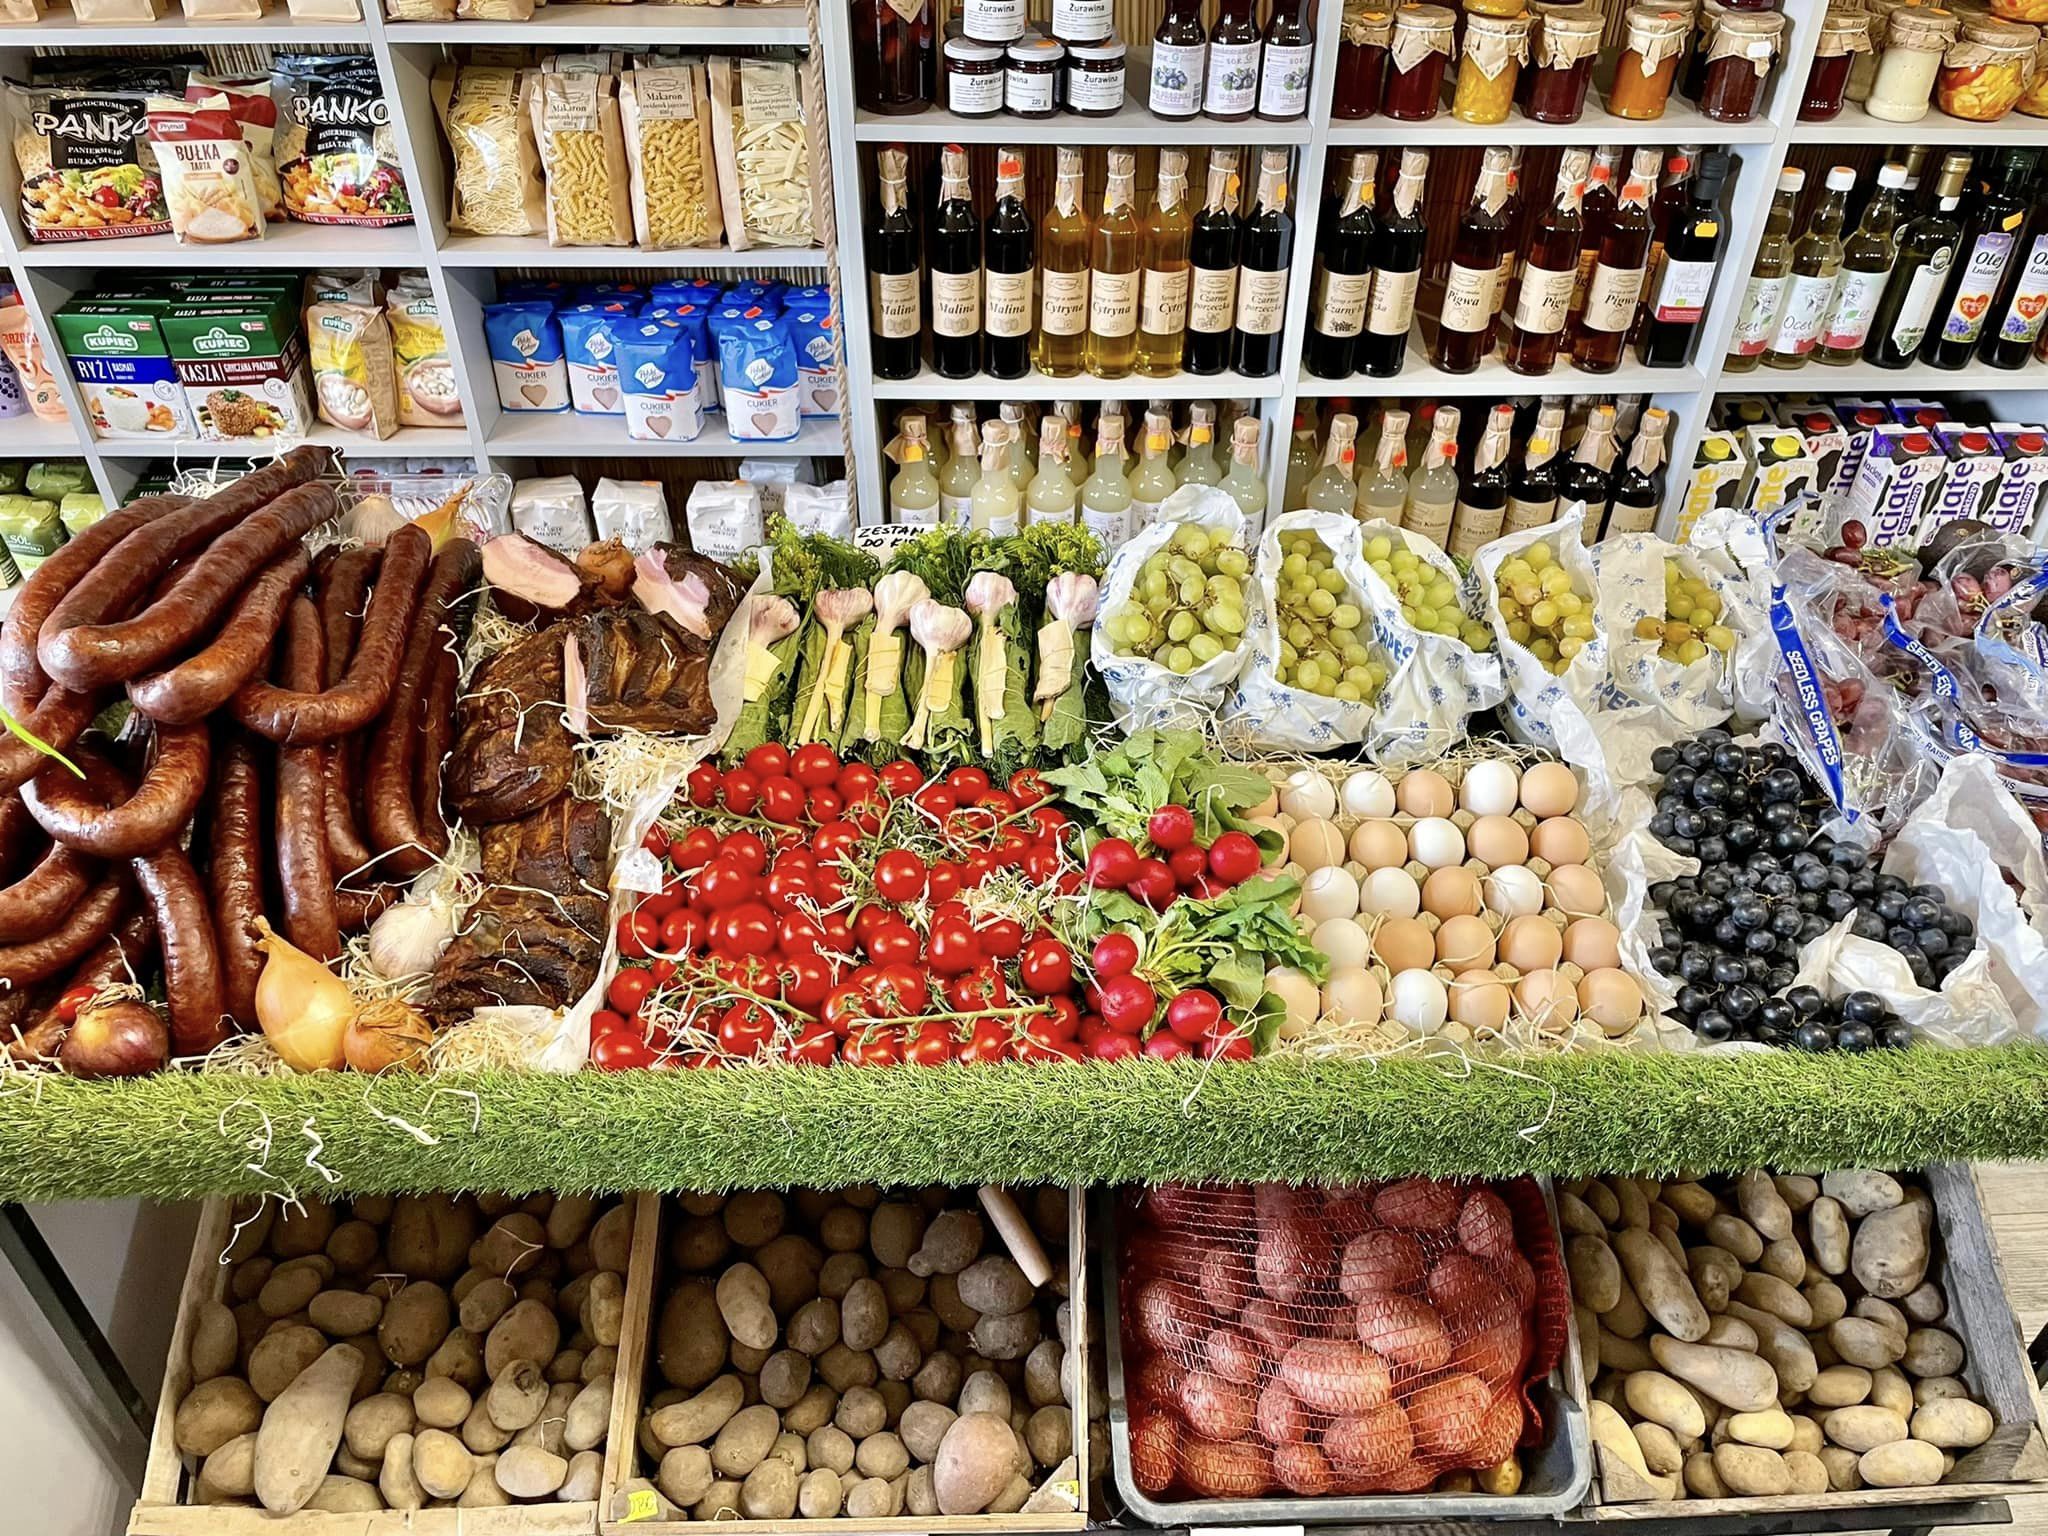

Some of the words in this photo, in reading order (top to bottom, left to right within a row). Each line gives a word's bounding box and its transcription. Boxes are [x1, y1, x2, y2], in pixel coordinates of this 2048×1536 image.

[979, 2, 1014, 12] Żurawina
[1069, 2, 1105, 12] Żurawina
[647, 92, 682, 101] Makaron
[292, 96, 391, 125] PANKO
[552, 104, 587, 112] Makaron
[33, 112, 149, 143] PANKO
[175, 144, 221, 160] BUŁKA
[190, 162, 212, 171] TARTA
[100, 226, 148, 236] WITHOUT
[1975, 251, 2008, 268] Olej
[1448, 290, 1479, 306] Pigwa
[880, 304, 916, 315] Malina
[939, 302, 974, 314] Malina
[990, 302, 1025, 314] Malina
[1045, 301, 1084, 316] Cytryna
[1093, 302, 1131, 317] Cytryna
[1783, 315, 1812, 331] Ocet
[88, 337, 133, 347] KUPIEC
[198, 338, 245, 350] KUPIEC
[77, 360, 107, 379] RYŻ
[179, 363, 221, 383] KASZA
[515, 371, 547, 380] CUKIER
[588, 374, 618, 382] CUKIER
[640, 402, 671, 411] CUKIER
[747, 399, 777, 408] CUKIER
[1988, 463, 2030, 530] ciate
[1874, 464, 1918, 548] aciate
[861, 538, 884, 547] DO
[1787, 651, 1819, 710] SEEDLESS
[1809, 712, 1838, 766] GRAPES
[1925, 742, 1952, 763] RAISIN
